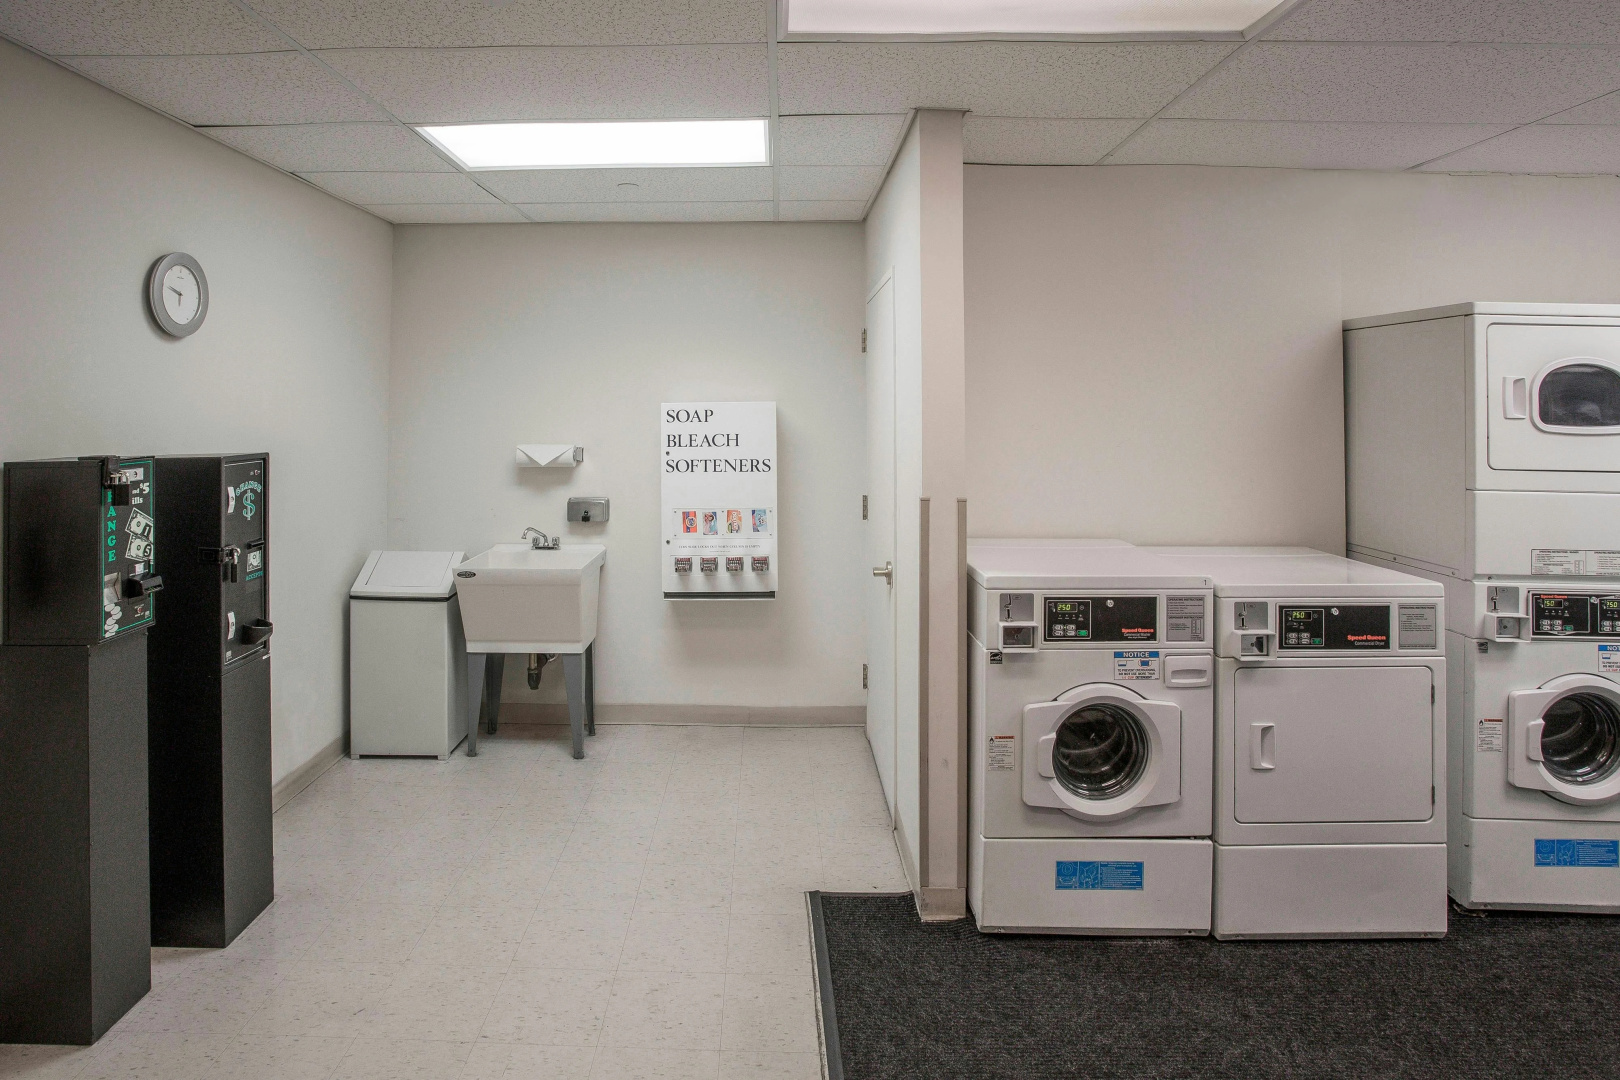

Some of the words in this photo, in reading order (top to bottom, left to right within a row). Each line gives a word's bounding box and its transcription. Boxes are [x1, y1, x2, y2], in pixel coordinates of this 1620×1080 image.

[666, 409, 714, 423] SOAP
[666, 434, 740, 448] BLEACH
[666, 459, 771, 473] SOFTENERS
[236, 481, 262, 496] CHANGE
